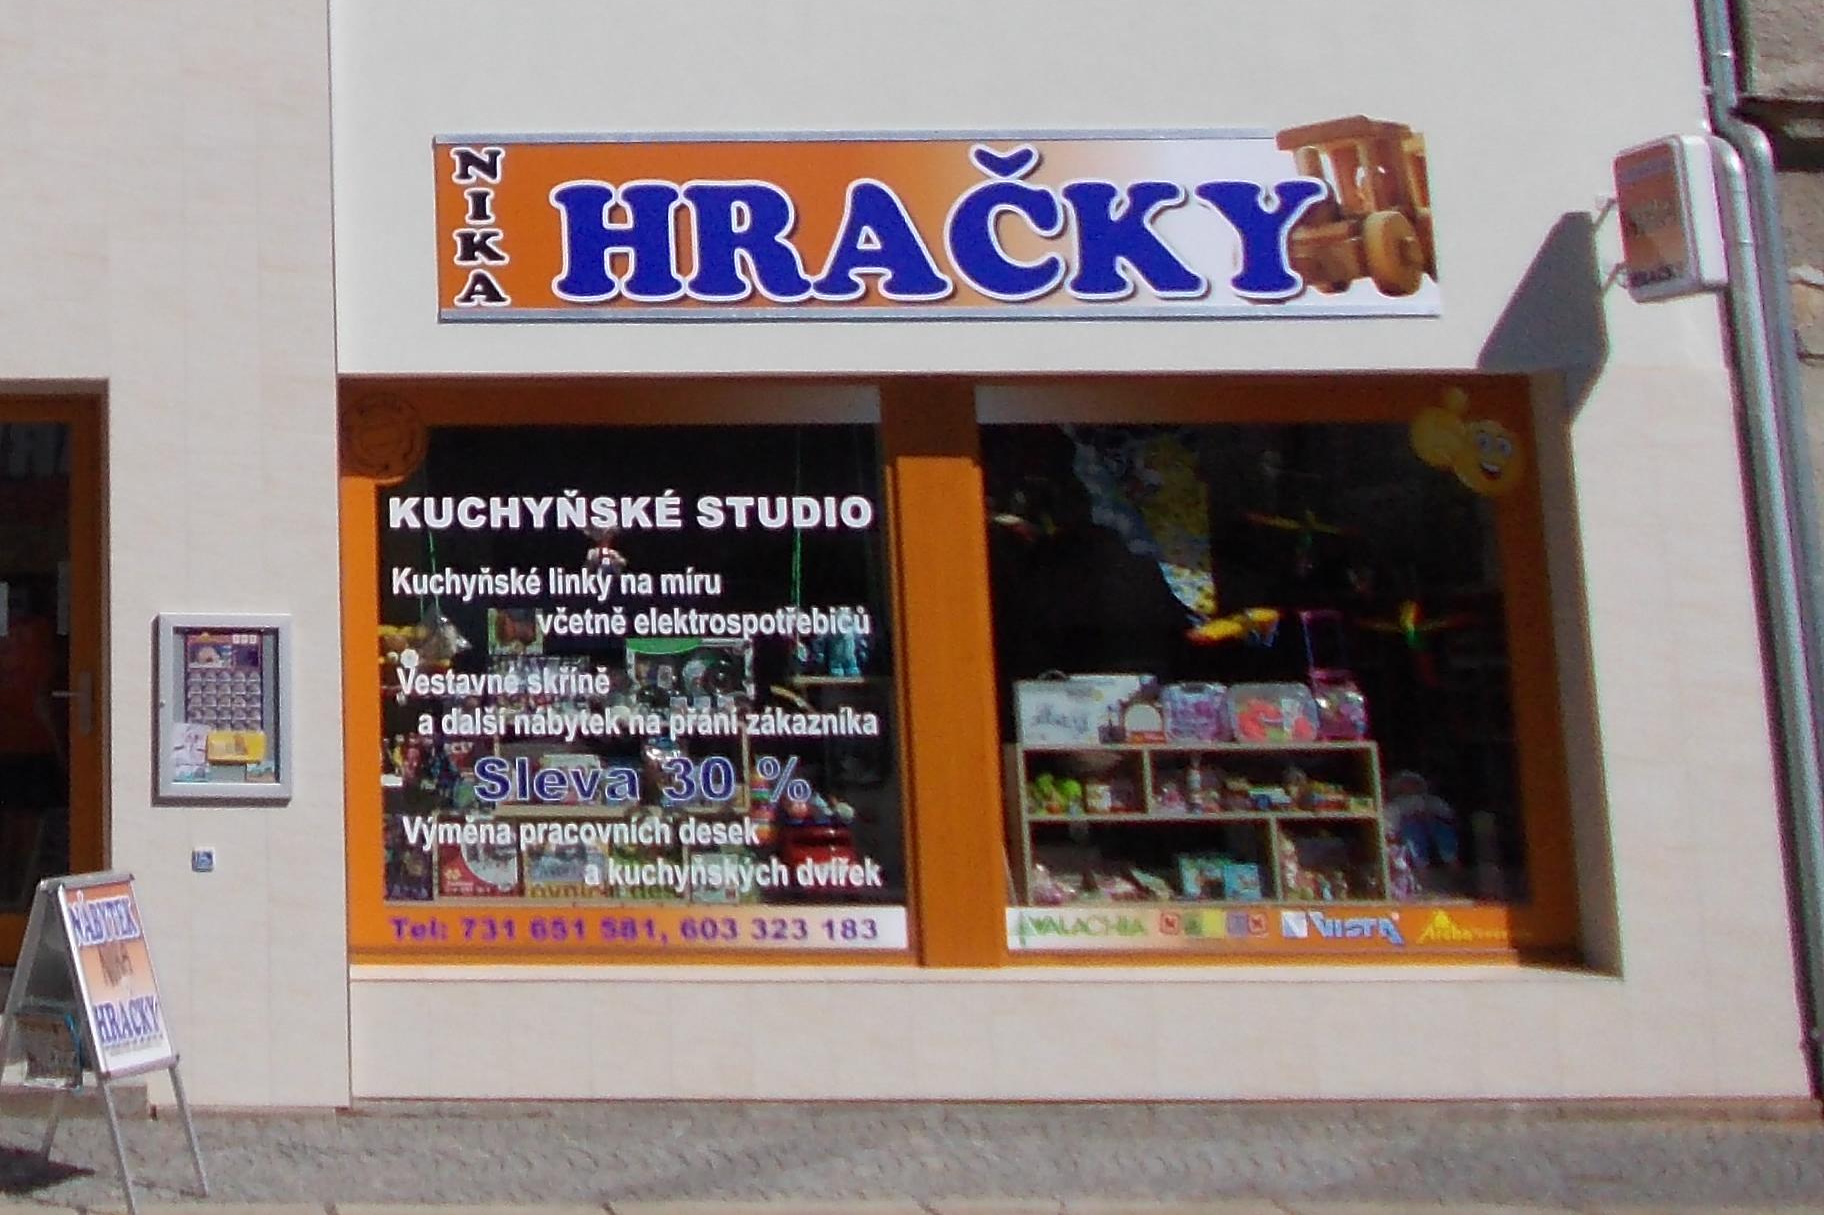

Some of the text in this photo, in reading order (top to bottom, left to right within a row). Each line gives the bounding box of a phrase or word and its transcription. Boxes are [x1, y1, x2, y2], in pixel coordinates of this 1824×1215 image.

[450, 146, 510, 307] NIKA
[548, 143, 1329, 302] HRAČKY
[388, 488, 874, 529] KUCHYŇSKÉ STUDIO
[391, 566, 722, 602] Kuchyňské linky na míru
[538, 605, 870, 641] včetně elektrospotřebičů
[396, 666, 610, 696] Vestavné skříně
[418, 706, 879, 742] a další nábytek na přání zákazníka
[474, 755, 812, 804] Sleva 30 %
[402, 814, 761, 851] Výměna pracovních desek
[585, 863, 601, 886] a
[609, 854, 789, 893] kuchyňských
[798, 855, 882, 887] dvířek
[461, 917, 517, 941] 731
[680, 917, 738, 941] 603
[751, 917, 809, 941] 323
[822, 917, 878, 941] 183
